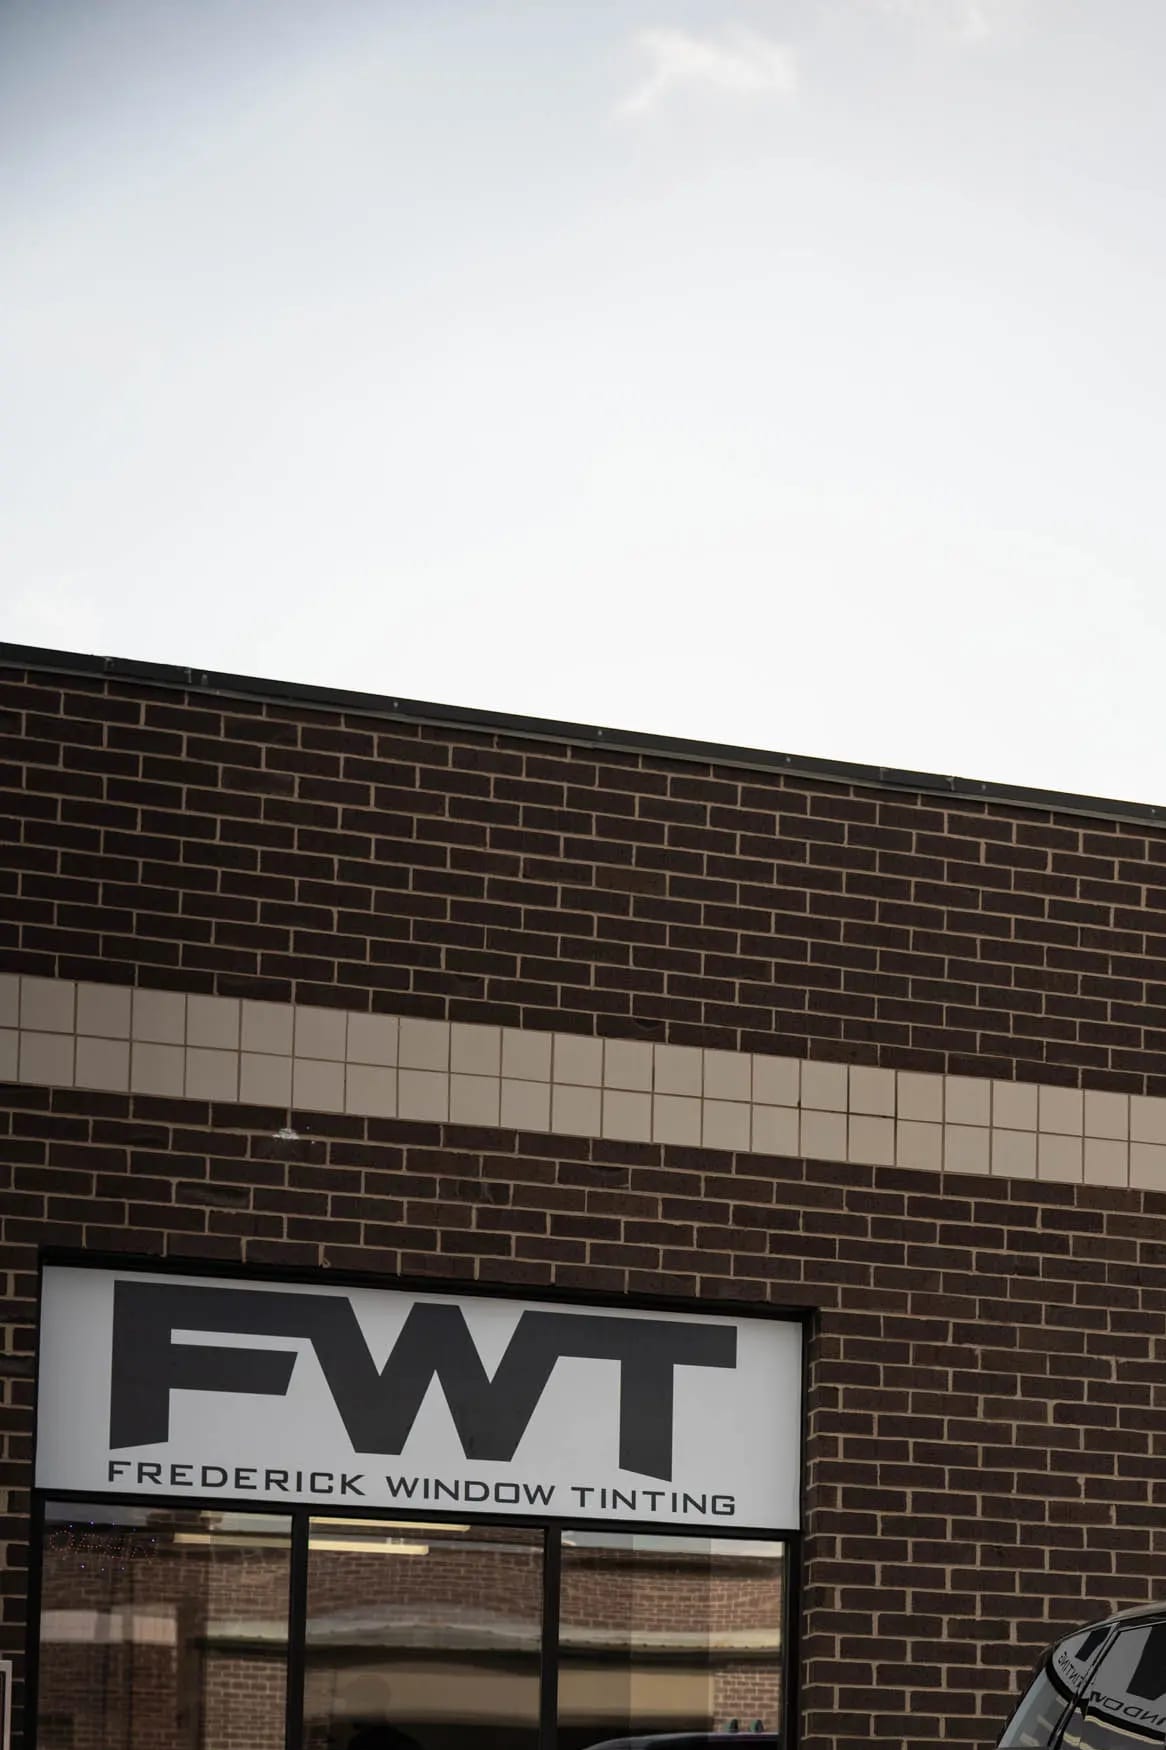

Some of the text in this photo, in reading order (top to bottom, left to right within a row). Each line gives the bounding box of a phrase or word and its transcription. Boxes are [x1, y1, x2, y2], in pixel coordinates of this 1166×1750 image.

[109, 1279, 738, 1482] FWT
[107, 1460, 736, 1516] FREDERICK WINDOW TINTING
